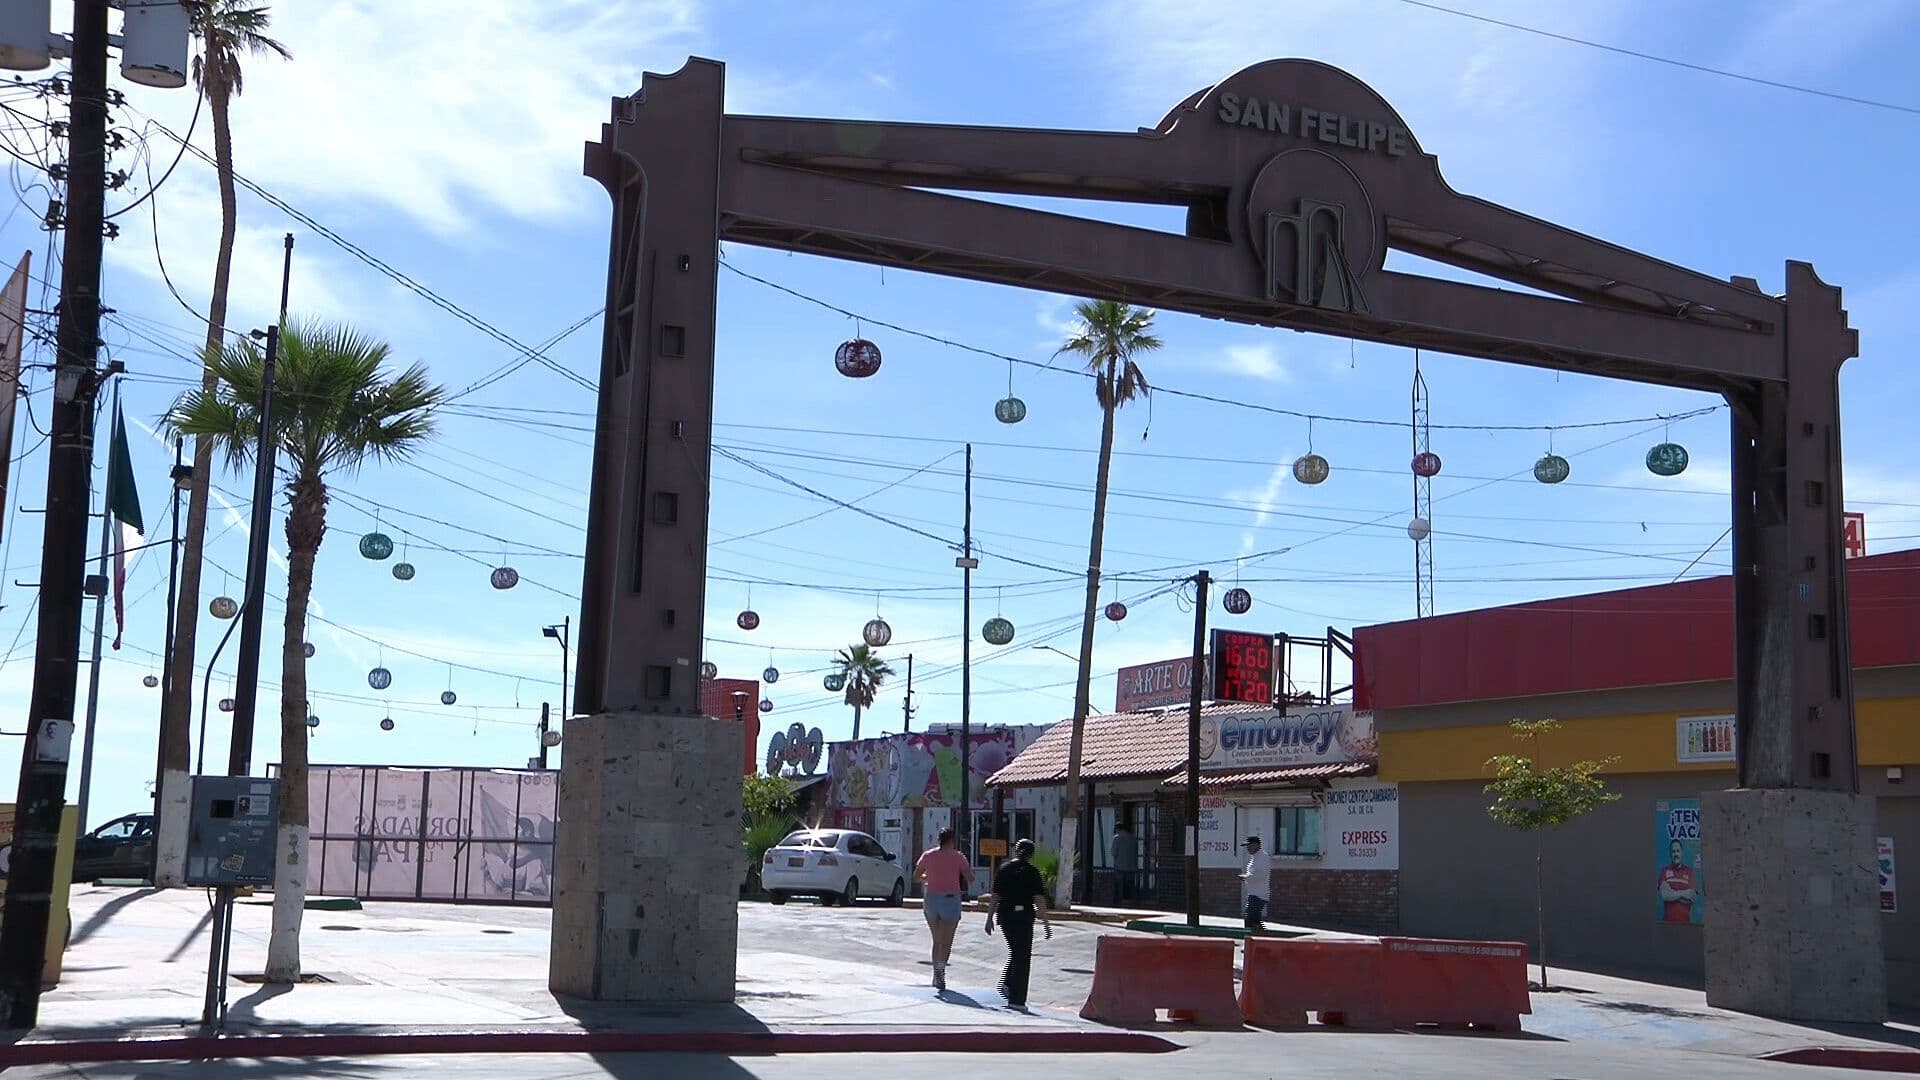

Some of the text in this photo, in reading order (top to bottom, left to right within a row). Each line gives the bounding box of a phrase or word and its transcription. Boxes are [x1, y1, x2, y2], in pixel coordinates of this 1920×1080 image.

[1218, 92, 1408, 156] SAN FELIPE
[1133, 664, 1173, 694] ARTE
[1220, 710, 1342, 755] emoney
[1342, 831, 1387, 844] EXPRESS
